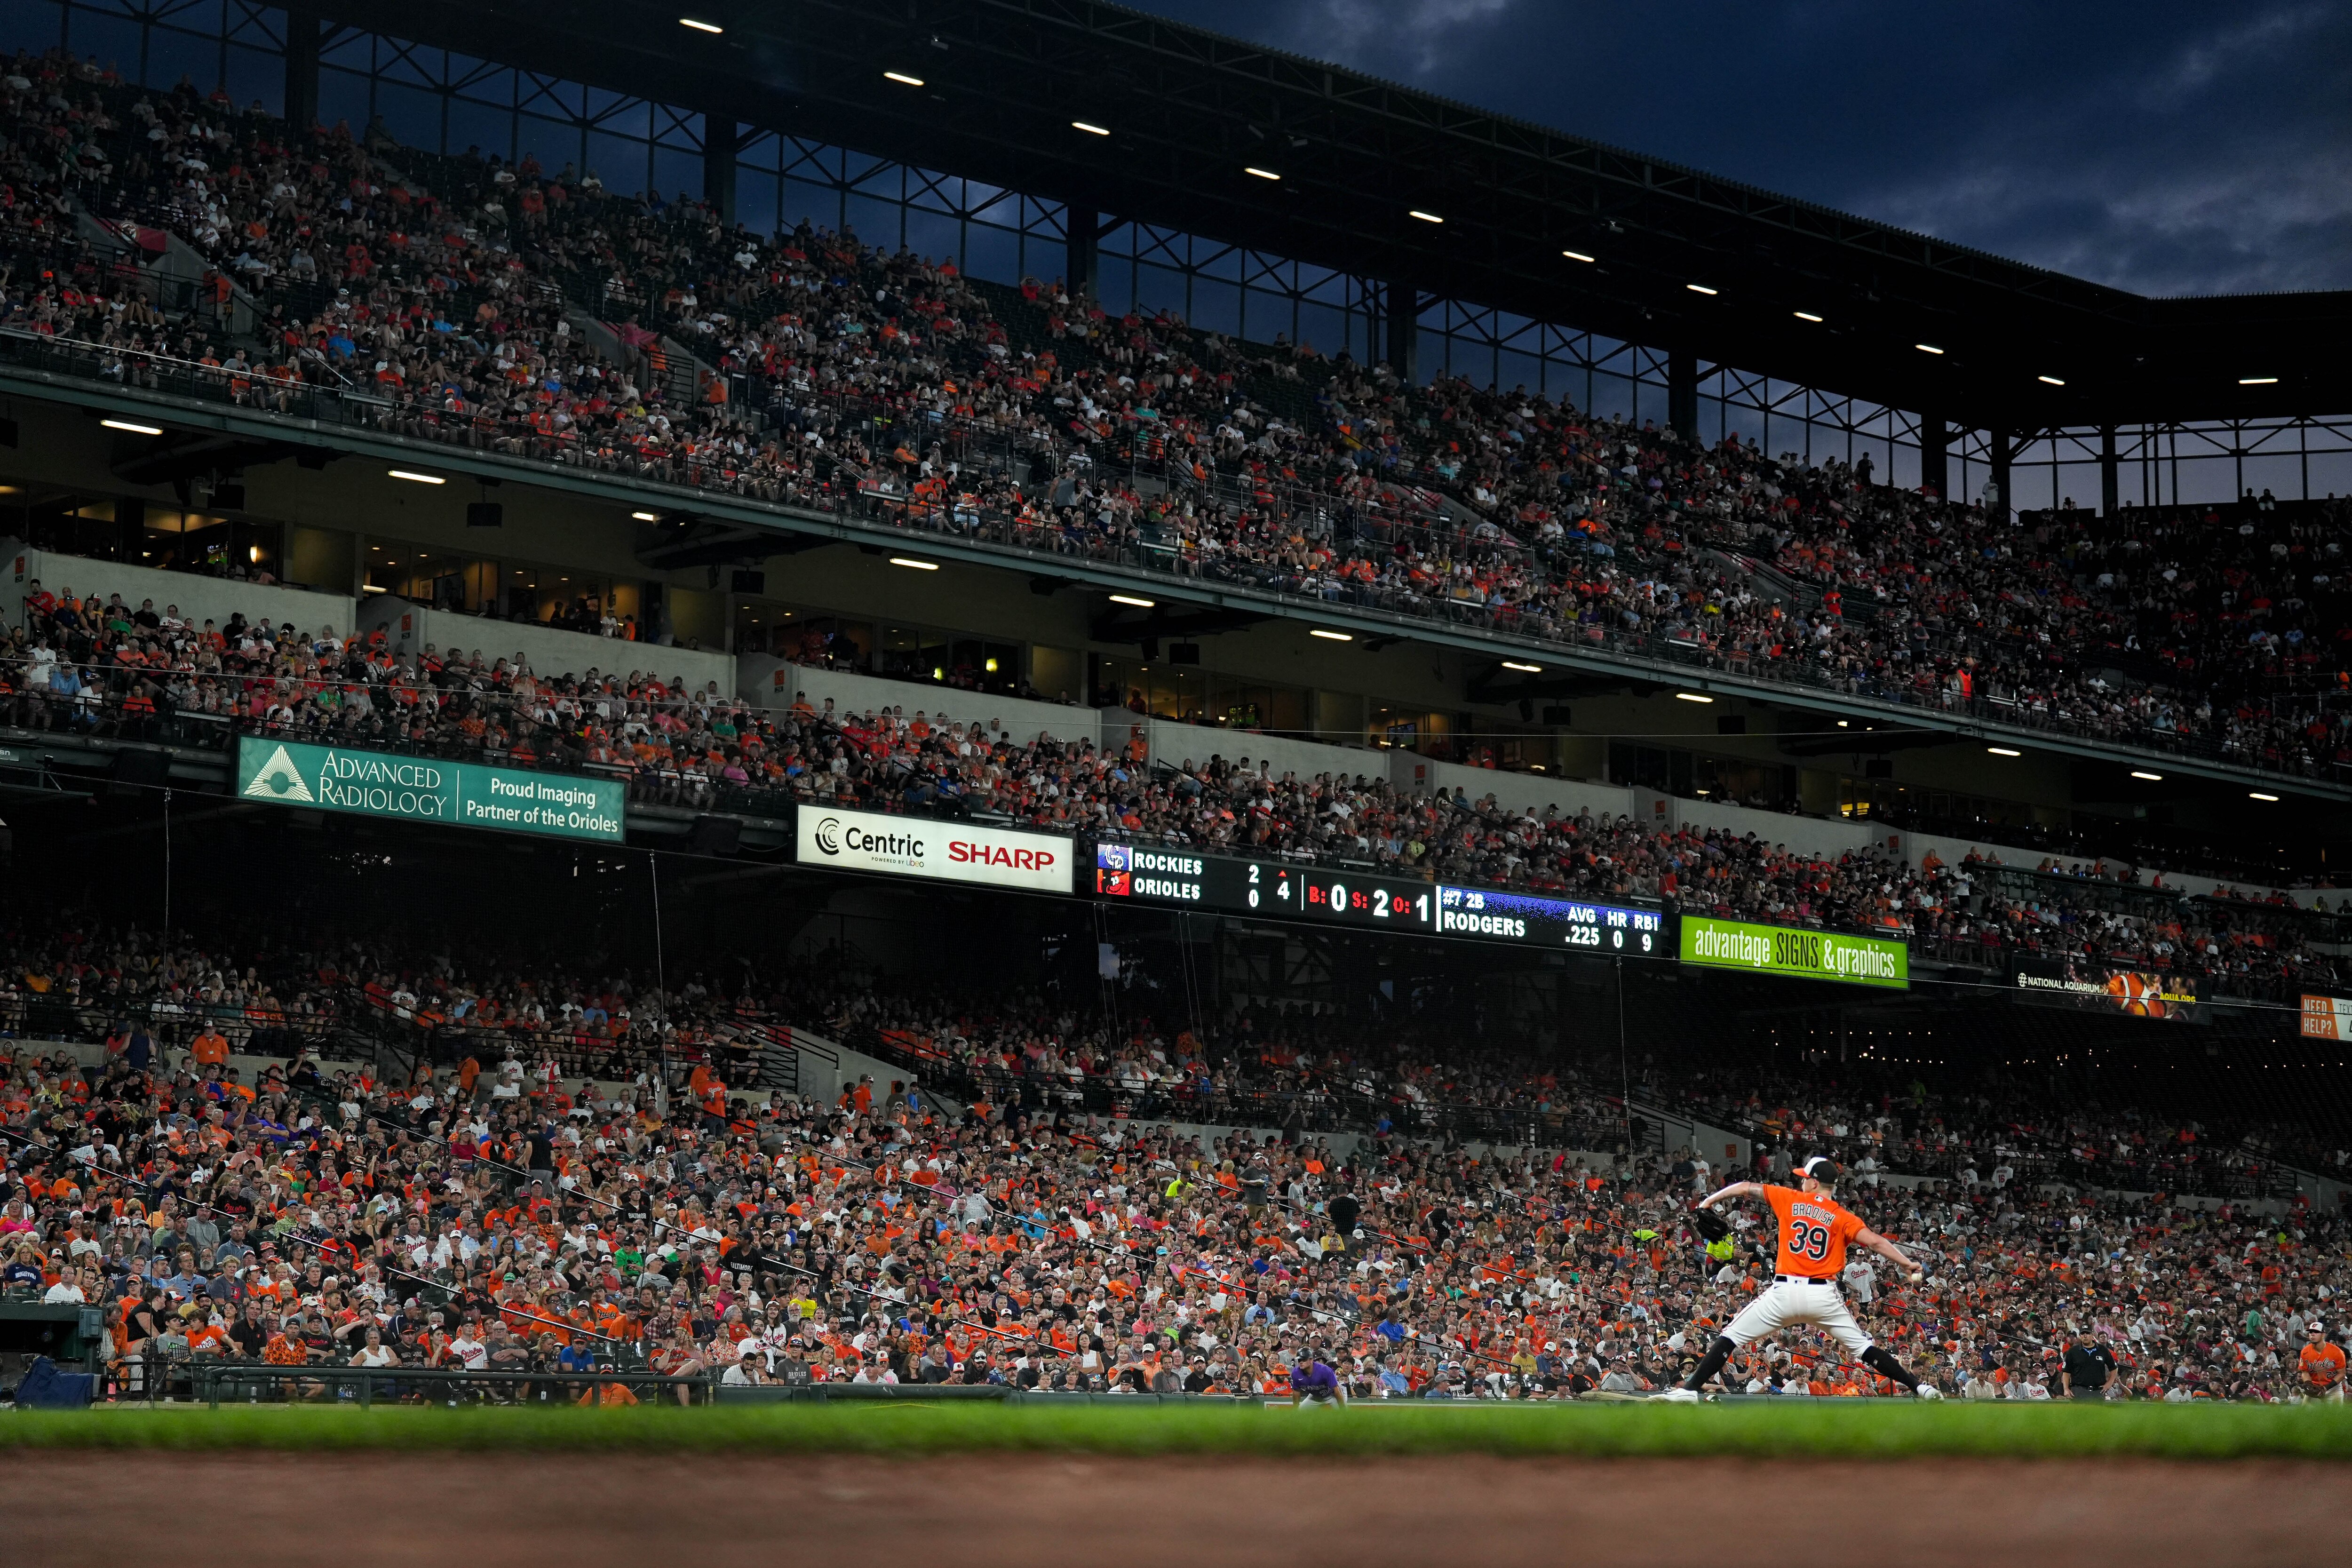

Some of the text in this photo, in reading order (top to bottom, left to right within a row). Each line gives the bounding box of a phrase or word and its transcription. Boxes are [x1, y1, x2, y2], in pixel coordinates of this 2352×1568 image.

[320, 750, 440, 788] ADVANCED
[319, 777, 447, 816] RADIOLOGY
[491, 778, 596, 810] Proud Imaging
[467, 800, 618, 833] Partner of the Orioles
[845, 827, 924, 858] Centric
[948, 841, 1054, 871] SHARP
[906, 857, 924, 868] ubeo
[1135, 852, 1259, 883] ROCKIES 2
[1134, 877, 1259, 907] ORIOLES 0
[1277, 881, 1290, 899] 4
[1310, 886, 1326, 904] B:
[1331, 884, 1346, 912] 0
[1352, 891, 1367, 909] S:
[1373, 889, 1389, 917] 2
[1416, 894, 1428, 922] 1
[1443, 889, 1485, 909] #7 2B
[1444, 911, 1525, 937] RODGERS
[1567, 906, 1658, 931] AVG HR RBI
[1565, 925, 1652, 952] .225 0 9
[1695, 923, 1770, 967] advantage
[1776, 932, 1819, 968] SIGNS
[2028, 976, 2063, 989] NATIONAL
[2304, 999, 2327, 1016] NEED
[2304, 1017, 2332, 1035] HELP?
[1792, 1203, 1836, 1226] BRADISH
[1789, 1220, 1829, 1261] 39
[461, 1347, 484, 1362] Orioles
